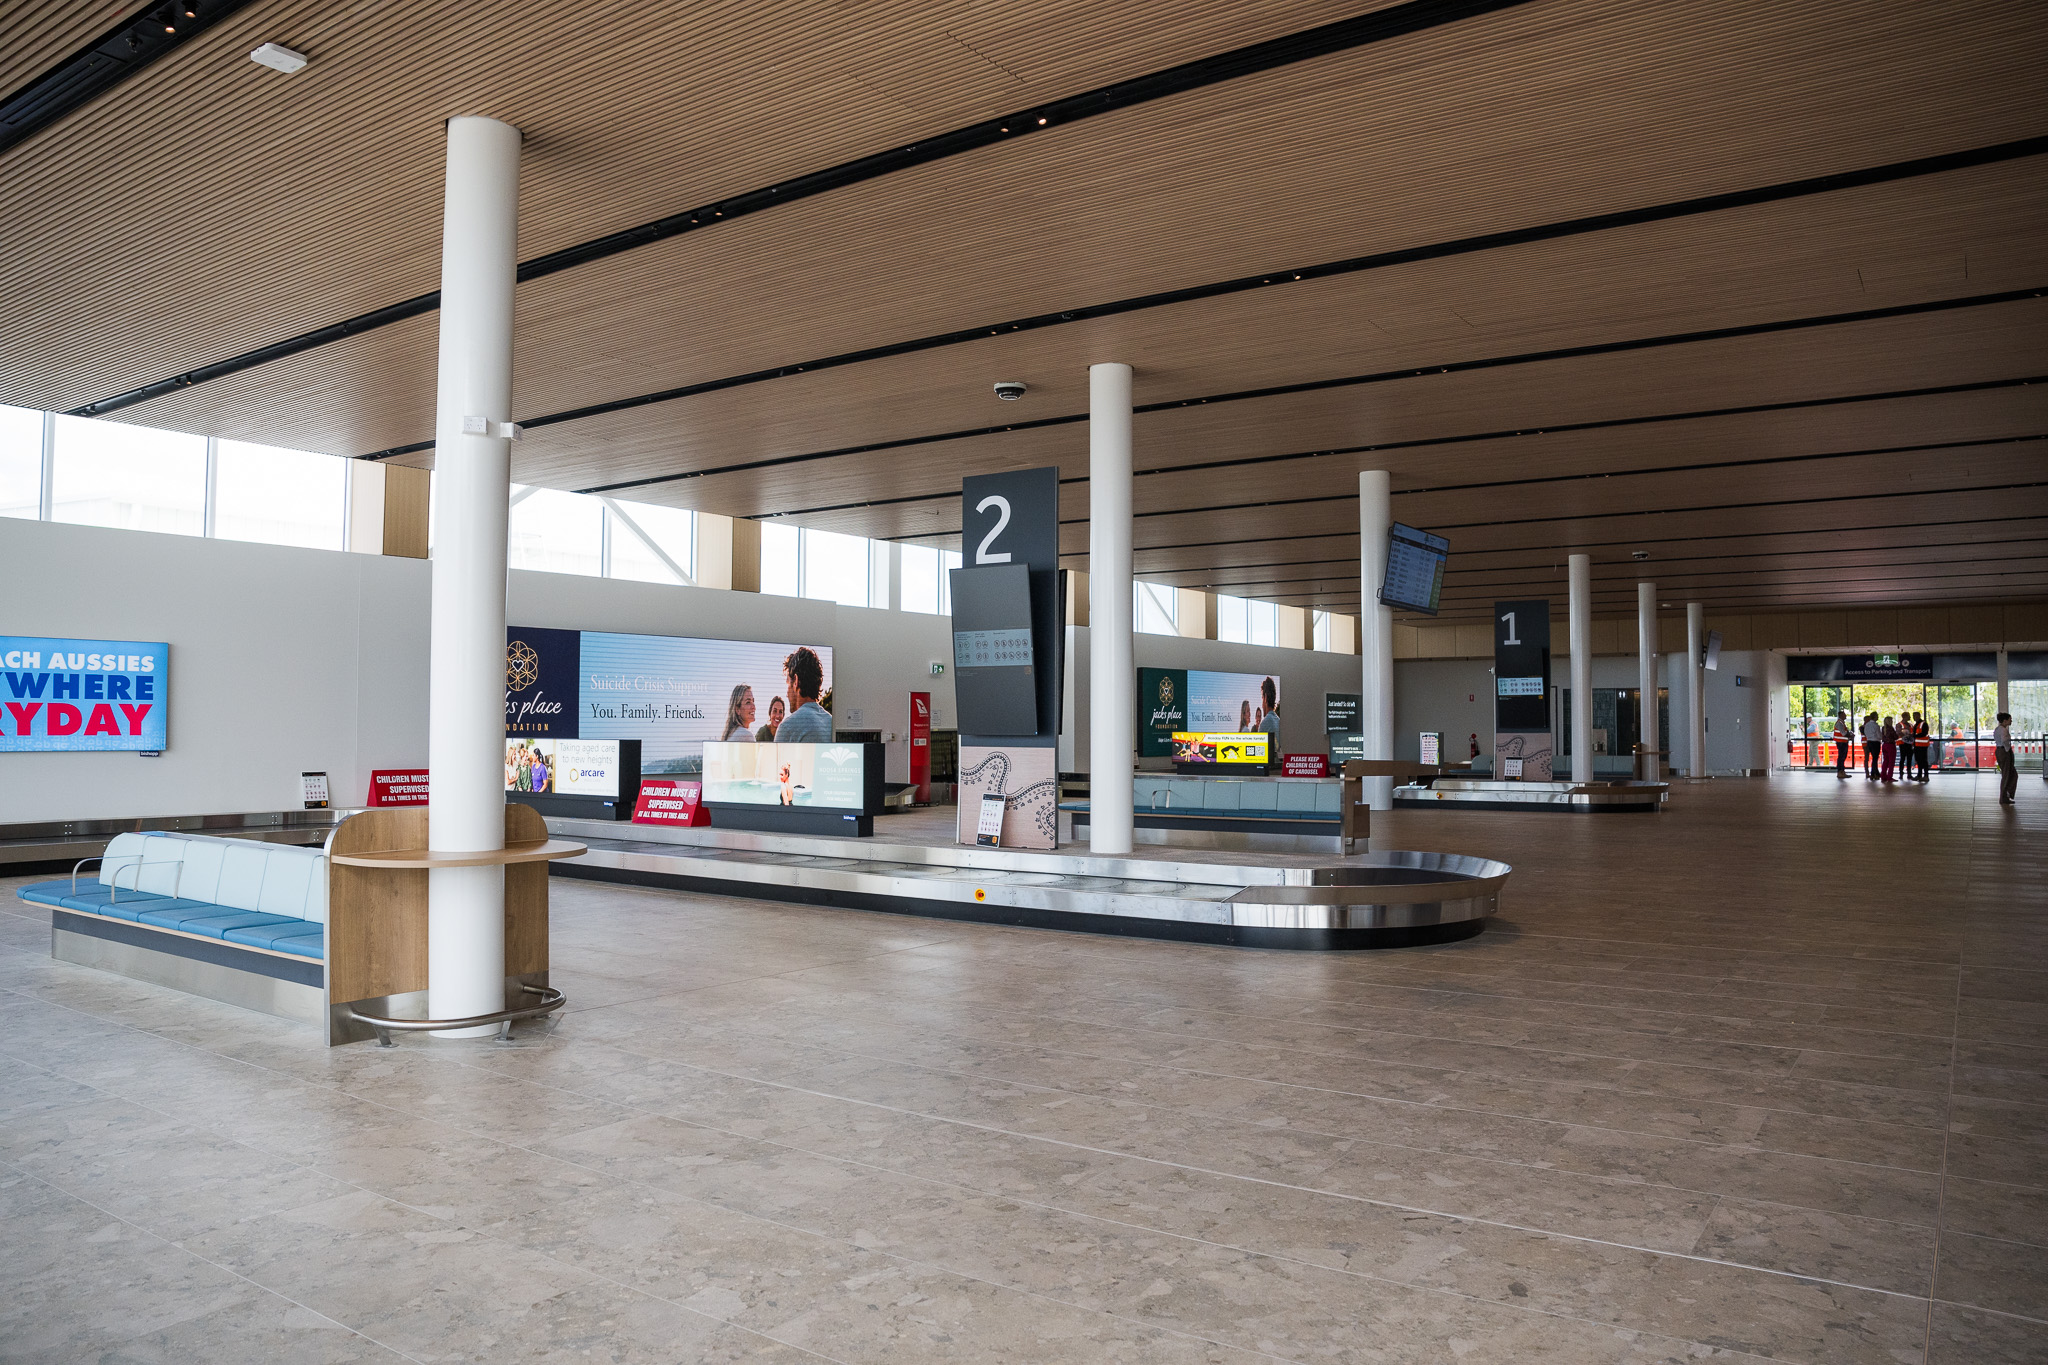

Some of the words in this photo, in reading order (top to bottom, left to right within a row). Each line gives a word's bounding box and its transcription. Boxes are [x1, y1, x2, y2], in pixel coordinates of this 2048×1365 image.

[975, 494, 1012, 565] 2
[1501, 611, 1522, 646] 1
[0, 651, 41, 669] CH
[47, 652, 155, 672] AUSSIES
[0, 671, 154, 700] WHERE
[590, 674, 631, 691] Suicide
[634, 675, 665, 692] Crisis
[666, 677, 709, 696] Support
[517, 690, 563, 723] place
[590, 703, 617, 719] You.
[621, 703, 661, 723] Family.
[664, 704, 705, 719] Friends.
[1150, 705, 1167, 726] jacks
[1166, 705, 1182, 724] place
[0, 702, 153, 736] YDAY
[560, 742, 581, 755] Taking
[582, 743, 599, 755] aged
[601, 745, 616, 753] care
[562, 755, 569, 763] to
[571, 756, 585, 764] new
[587, 754, 613, 766] heights
[376, 775, 410, 784] CHILDREN
[411, 775, 429, 783] MUST
[580, 769, 605, 778] arcare
[389, 785, 429, 794] SUPERVISED
[641, 786, 671, 797] CHILDREN
[670, 787, 688, 798] MUST
[687, 788, 698, 798] BE
[647, 799, 684, 810] SUPERVISED
[677, 812, 689, 820] AREA
